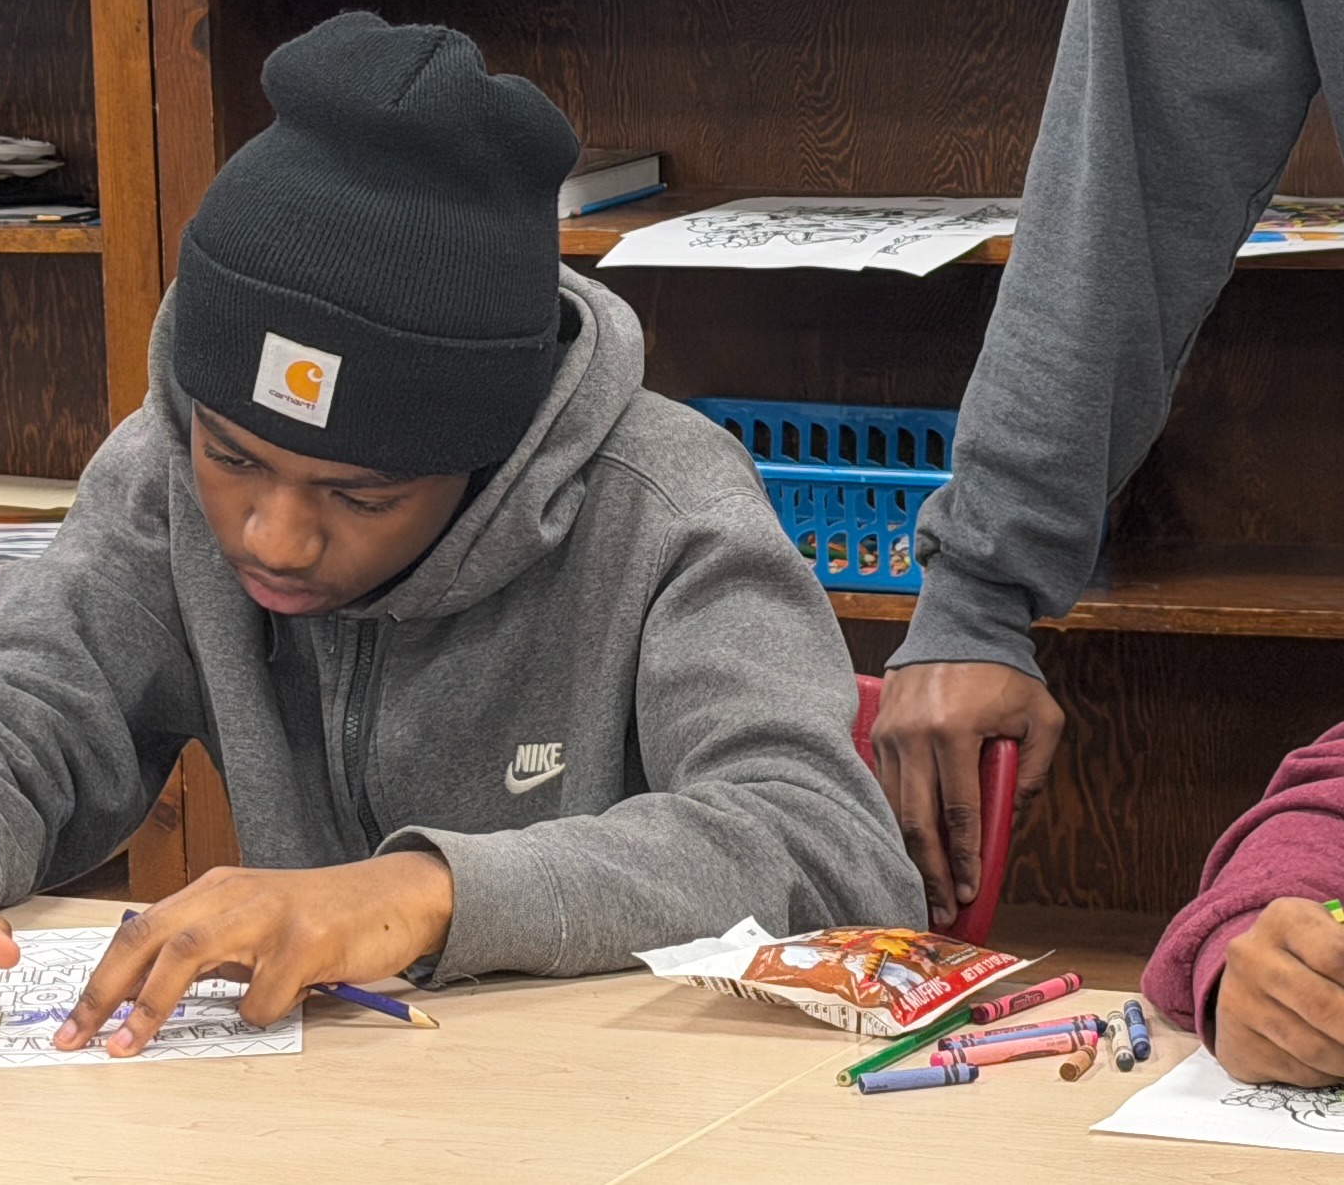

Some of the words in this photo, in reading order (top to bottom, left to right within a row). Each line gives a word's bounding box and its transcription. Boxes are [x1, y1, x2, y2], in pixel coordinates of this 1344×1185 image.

[268, 389, 316, 411] carhartt
[515, 742, 563, 773] NIKE
[907, 976, 952, 1013] MUFFINS
